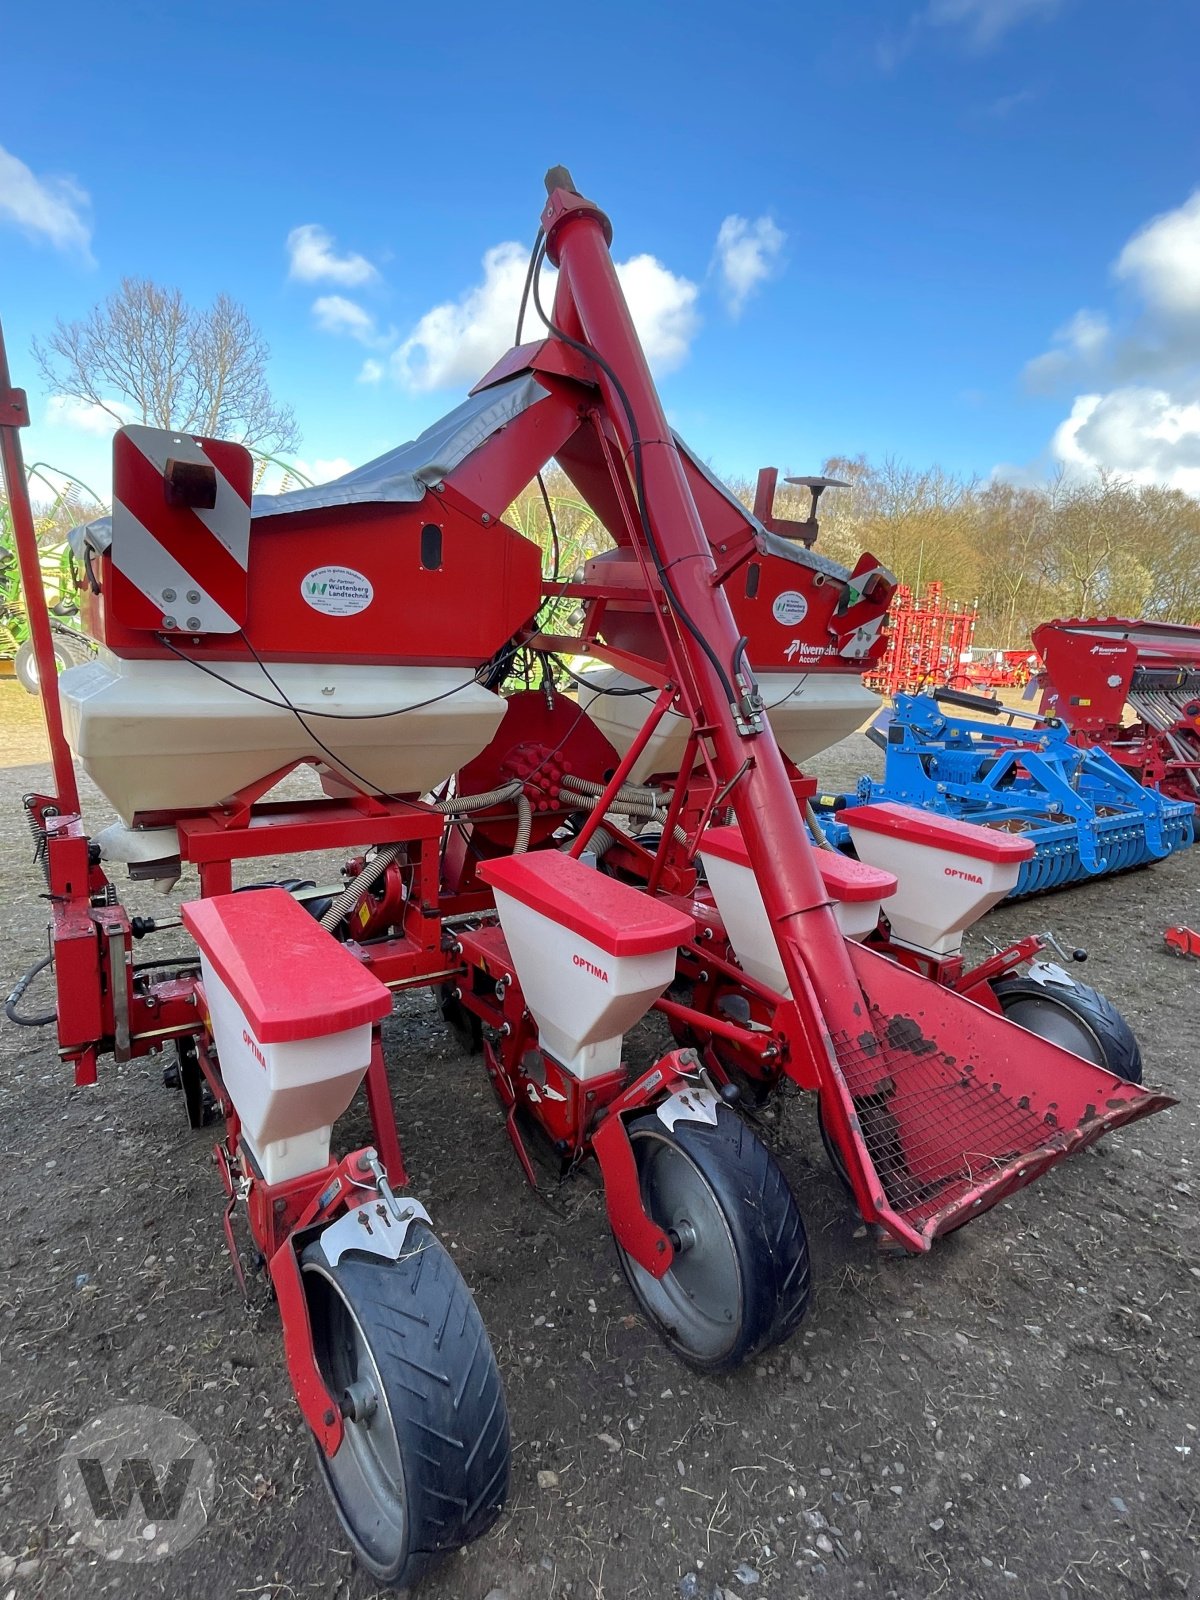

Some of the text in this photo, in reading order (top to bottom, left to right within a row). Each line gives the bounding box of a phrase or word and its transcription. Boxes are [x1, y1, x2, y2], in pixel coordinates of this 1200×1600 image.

[328, 583, 369, 594] Wüstenberg
[328, 591, 369, 599] Landtechnik
[800, 643, 839, 656] Kvernela
[944, 867, 983, 885] OPTIMA
[572, 954, 609, 984] OPTIMA
[242, 1029, 267, 1071] OPTIMA
